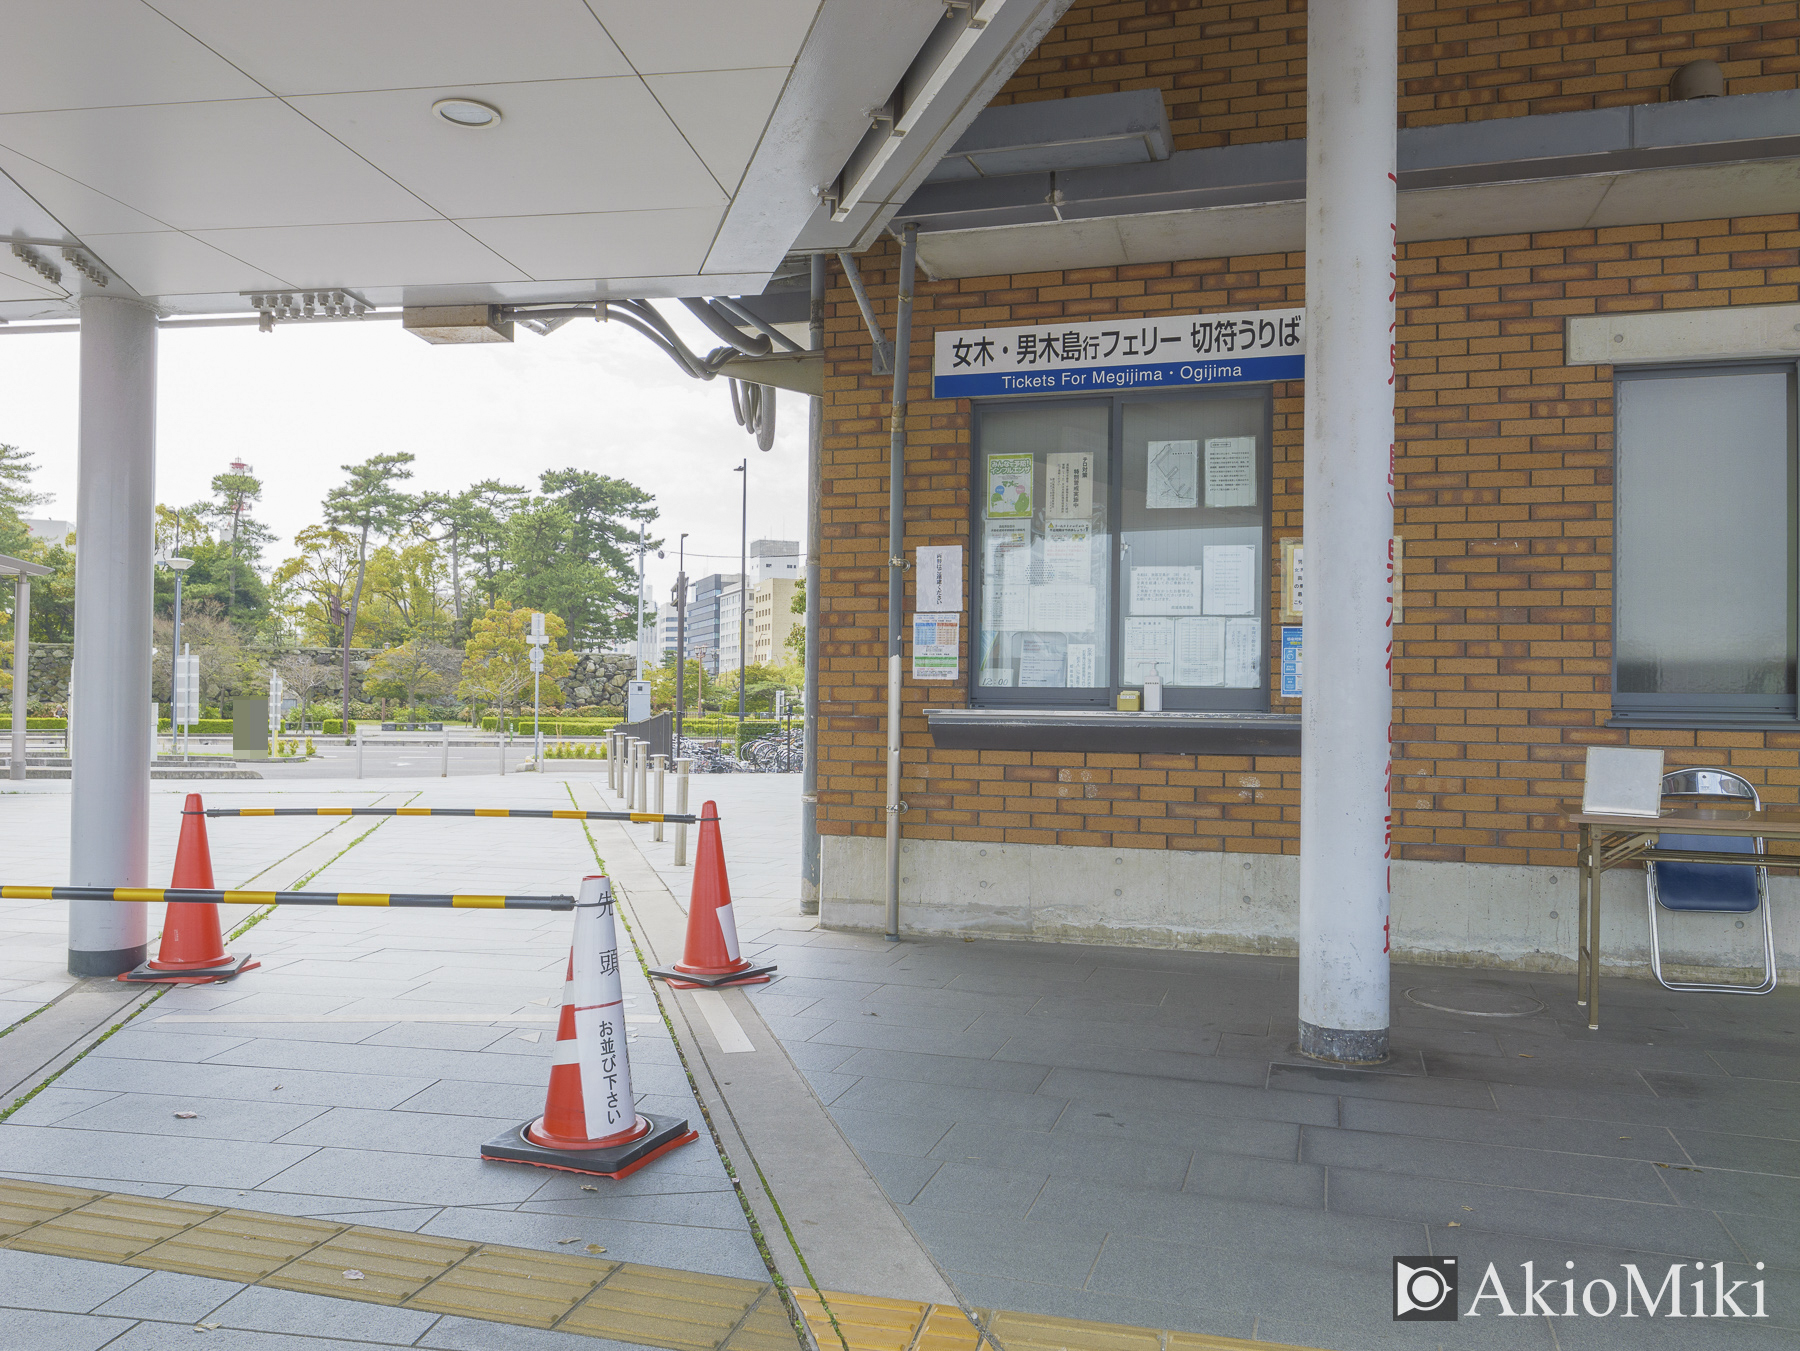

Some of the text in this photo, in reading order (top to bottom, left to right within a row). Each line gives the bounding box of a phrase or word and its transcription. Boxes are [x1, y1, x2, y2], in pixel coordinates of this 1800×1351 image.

[952, 315, 1301, 368] 女木・男木島行フェリー 切符うりば
[1001, 373, 1056, 390] Tickets
[1061, 371, 1087, 387] For
[1092, 367, 1163, 387] Megijima
[1180, 364, 1242, 382] Ogijima
[990, 467, 1031, 475] インフルエンザ
[599, 1020, 622, 1125] お並び下さい
